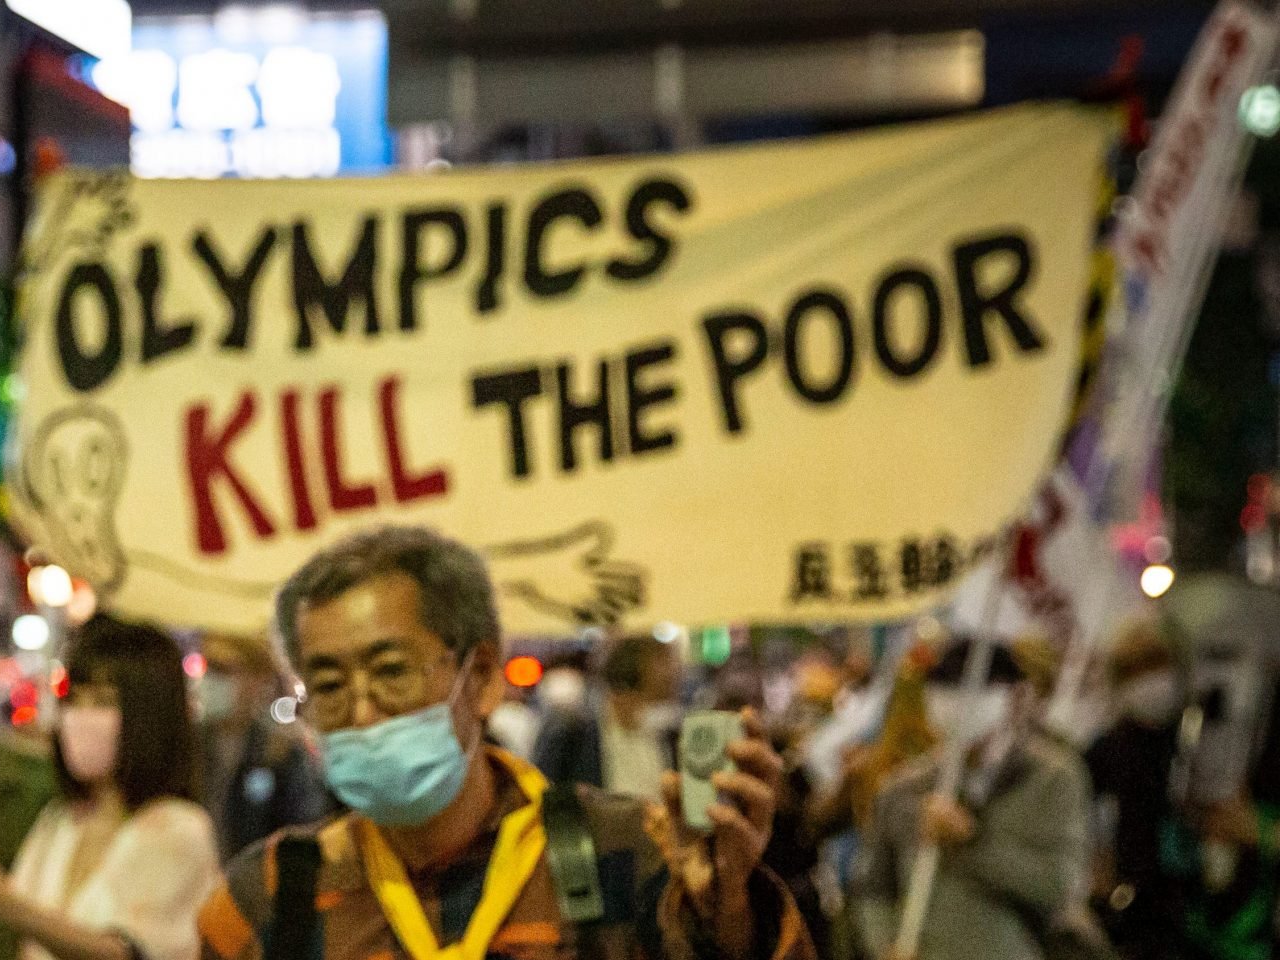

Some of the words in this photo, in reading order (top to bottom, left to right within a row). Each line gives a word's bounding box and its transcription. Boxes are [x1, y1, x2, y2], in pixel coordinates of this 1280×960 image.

[55, 174, 693, 392] OLYMPICS
[182, 376, 448, 555] KILL
[471, 337, 678, 479] THE
[702, 226, 1048, 435] POOR
